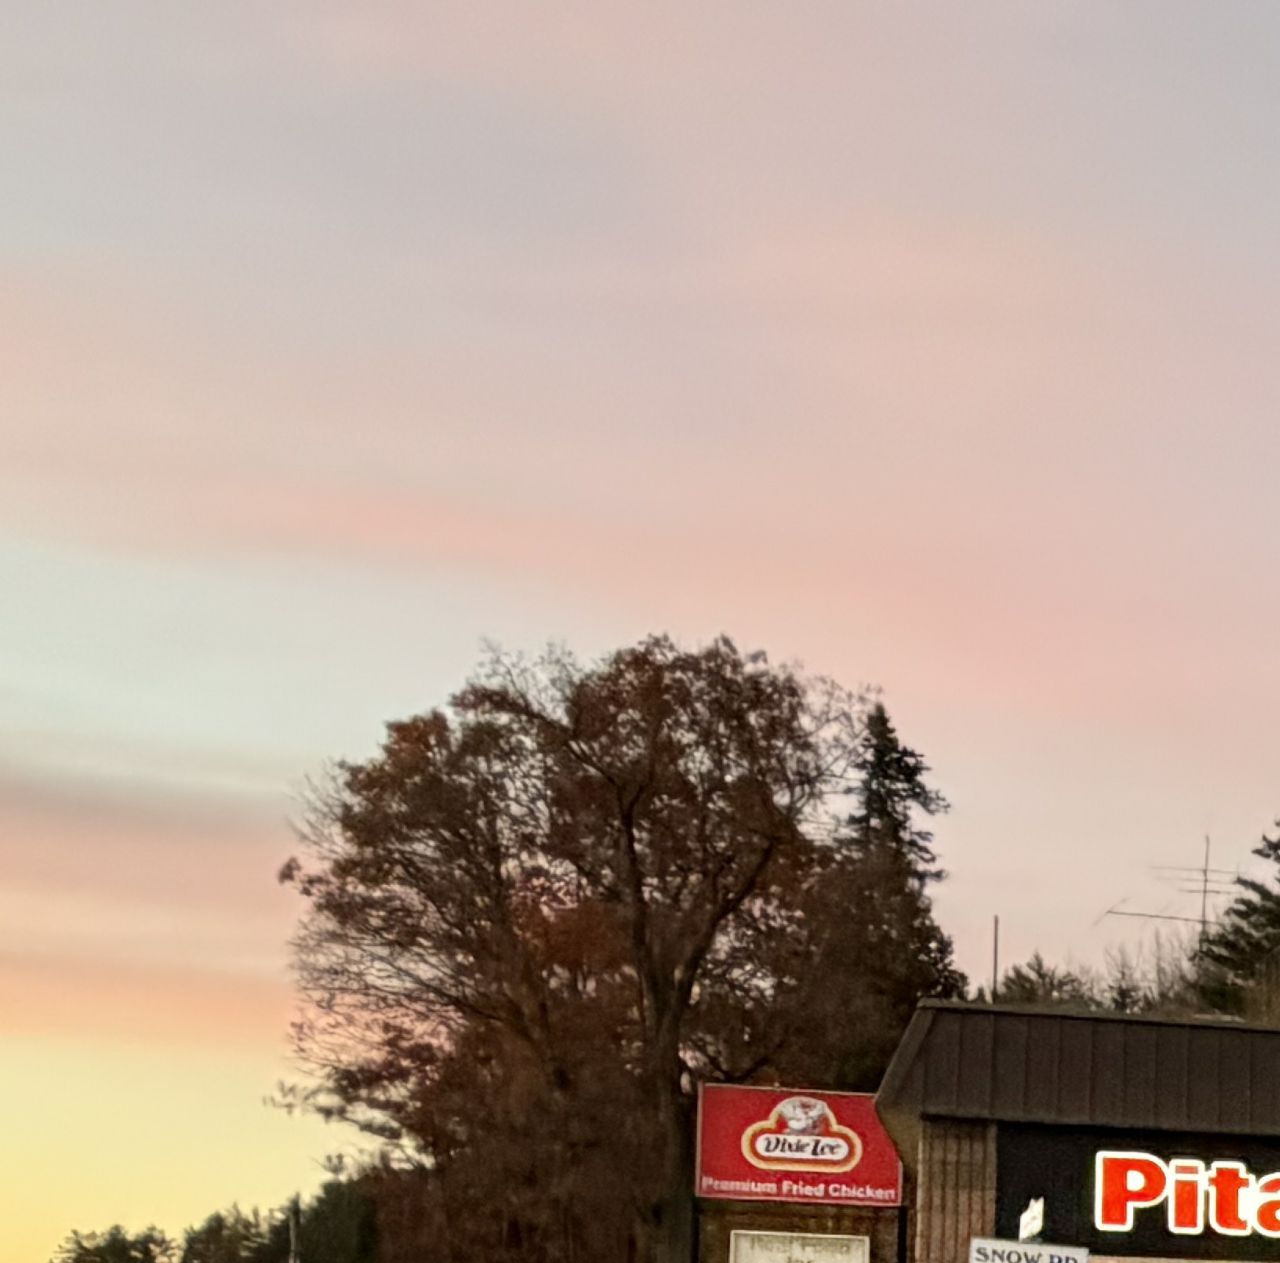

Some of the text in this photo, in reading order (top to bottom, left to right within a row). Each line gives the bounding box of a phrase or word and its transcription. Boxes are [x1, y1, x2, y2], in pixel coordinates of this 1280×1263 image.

[702, 1175, 897, 1201] Premium Fried Chicken
